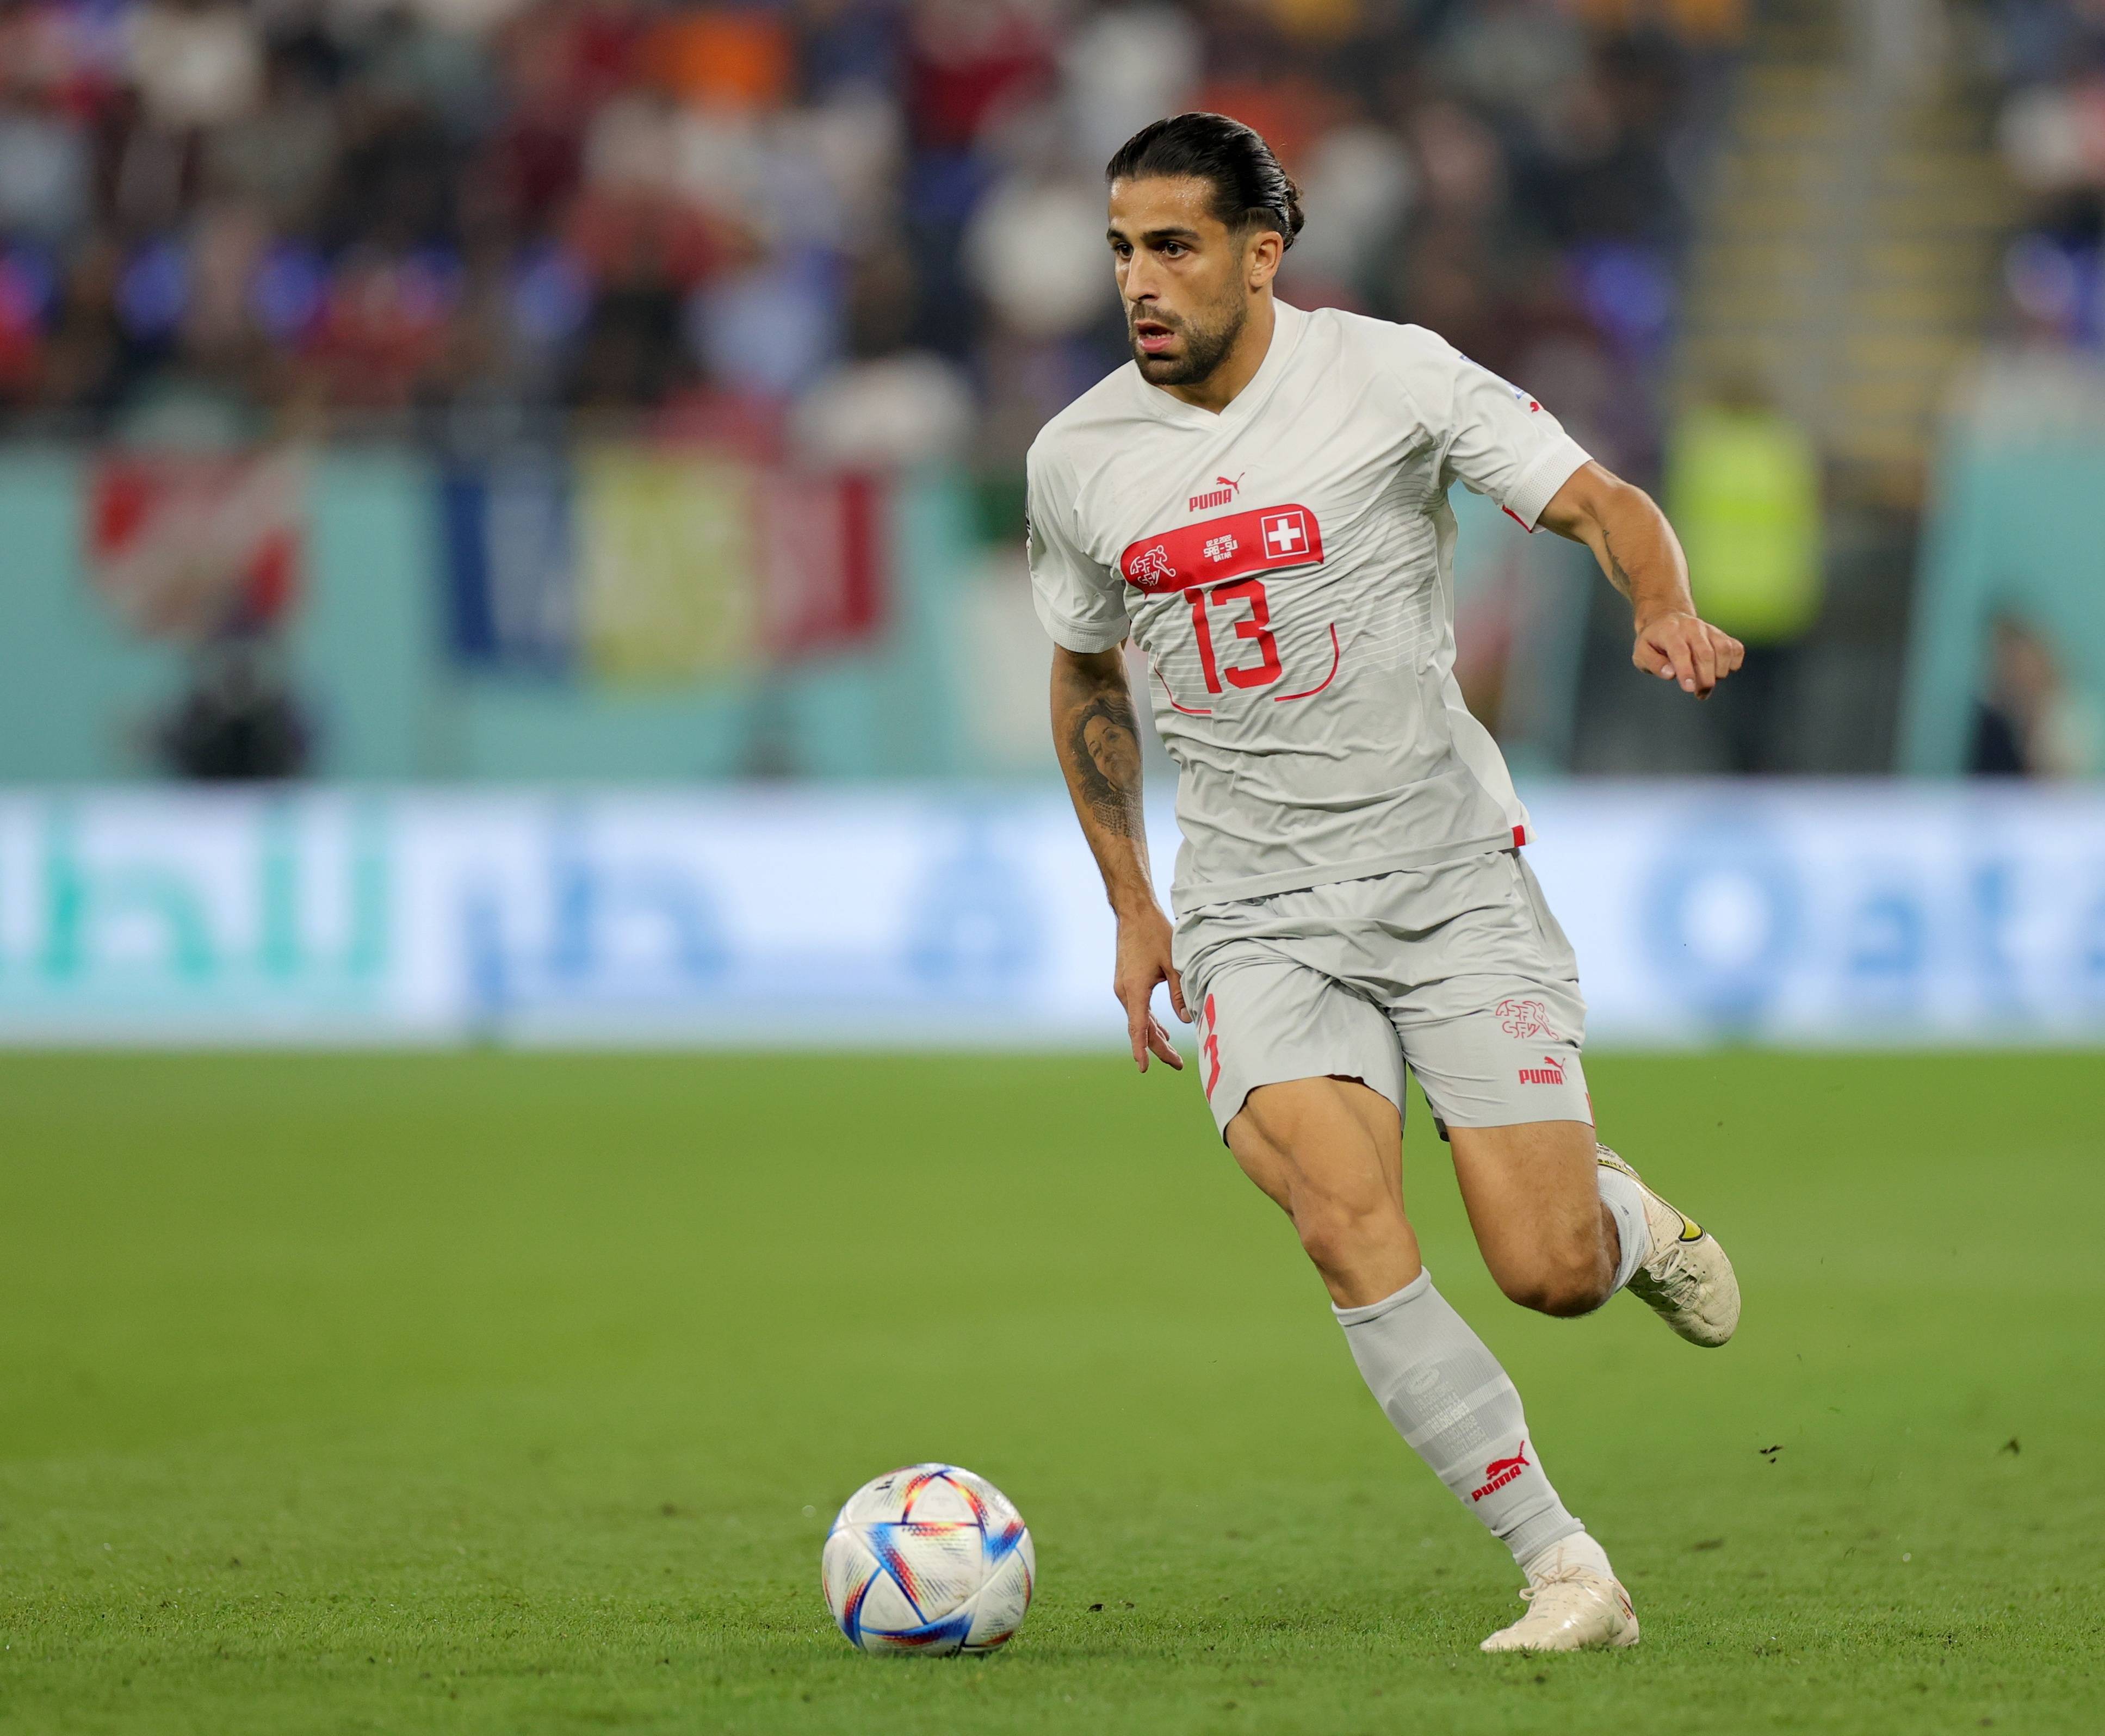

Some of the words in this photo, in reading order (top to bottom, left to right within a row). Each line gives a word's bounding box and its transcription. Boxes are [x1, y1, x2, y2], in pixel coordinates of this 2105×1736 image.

[1189, 488, 1231, 512] PUMA
[1184, 578, 1282, 694] 13
[1519, 1069, 1563, 1084] PUMA
[1471, 1465, 1522, 1502] PUMA
